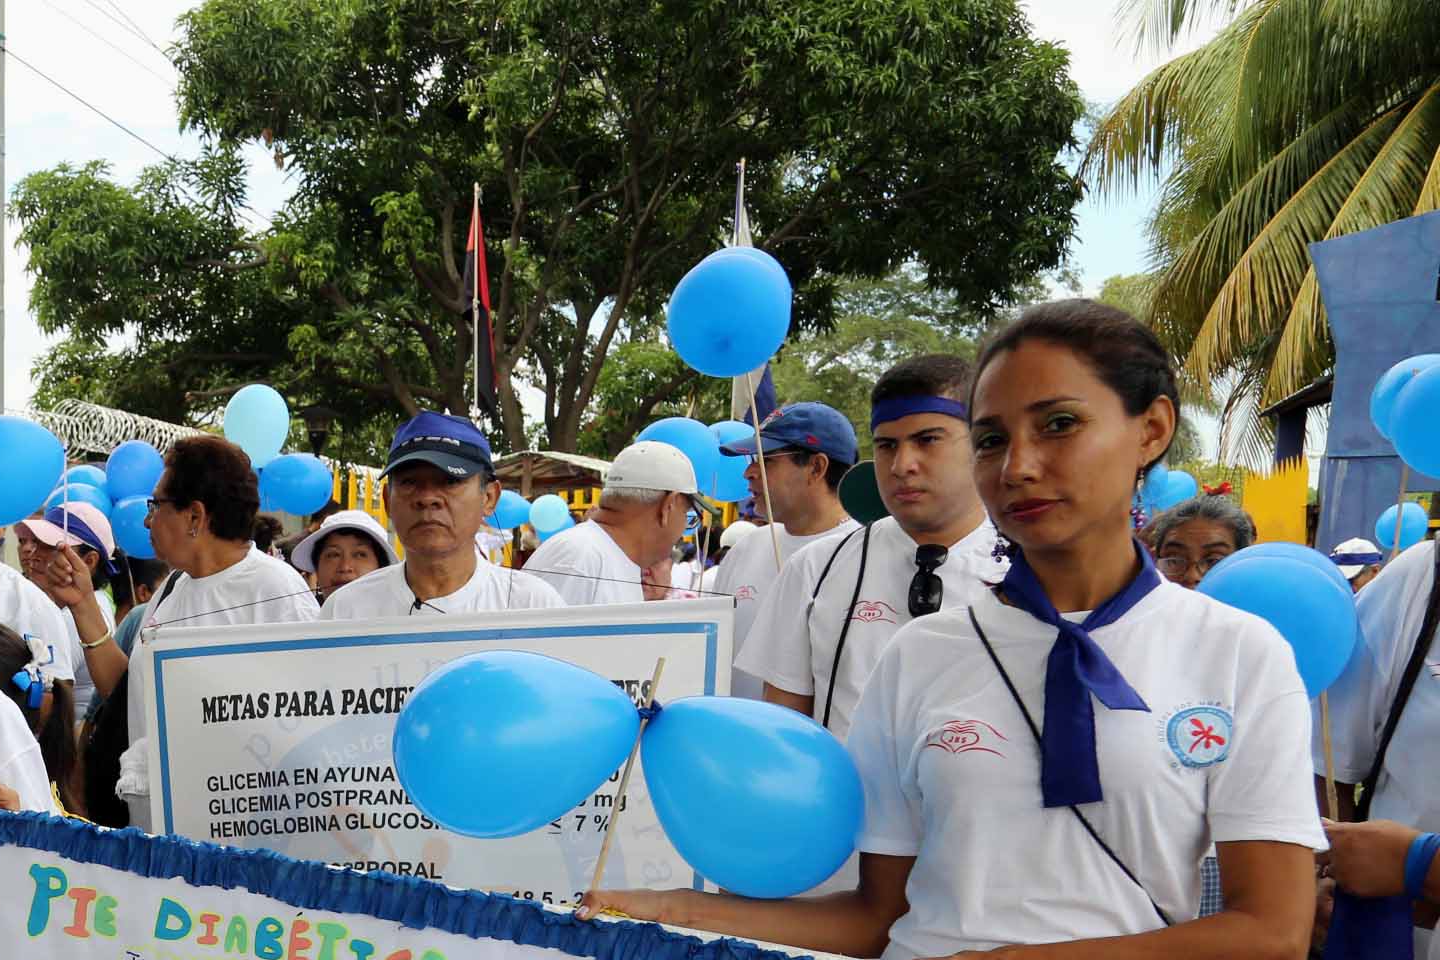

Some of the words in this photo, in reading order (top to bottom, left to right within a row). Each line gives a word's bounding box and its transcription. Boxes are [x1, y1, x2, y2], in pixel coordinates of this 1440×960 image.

[202, 693, 270, 724] METAS
[274, 690, 335, 717] PARA
[341, 686, 415, 715] PACIE
[207, 772, 289, 792] GLICEMIA
[293, 768, 318, 785] EN
[324, 766, 395, 784] AYUNA
[208, 797, 290, 815] GLICEMIA
[211, 814, 340, 839] HEMOGLOBINA
[345, 811, 441, 830] GLUCOS
[575, 815, 587, 832] 7
[27, 863, 119, 938] PIE
